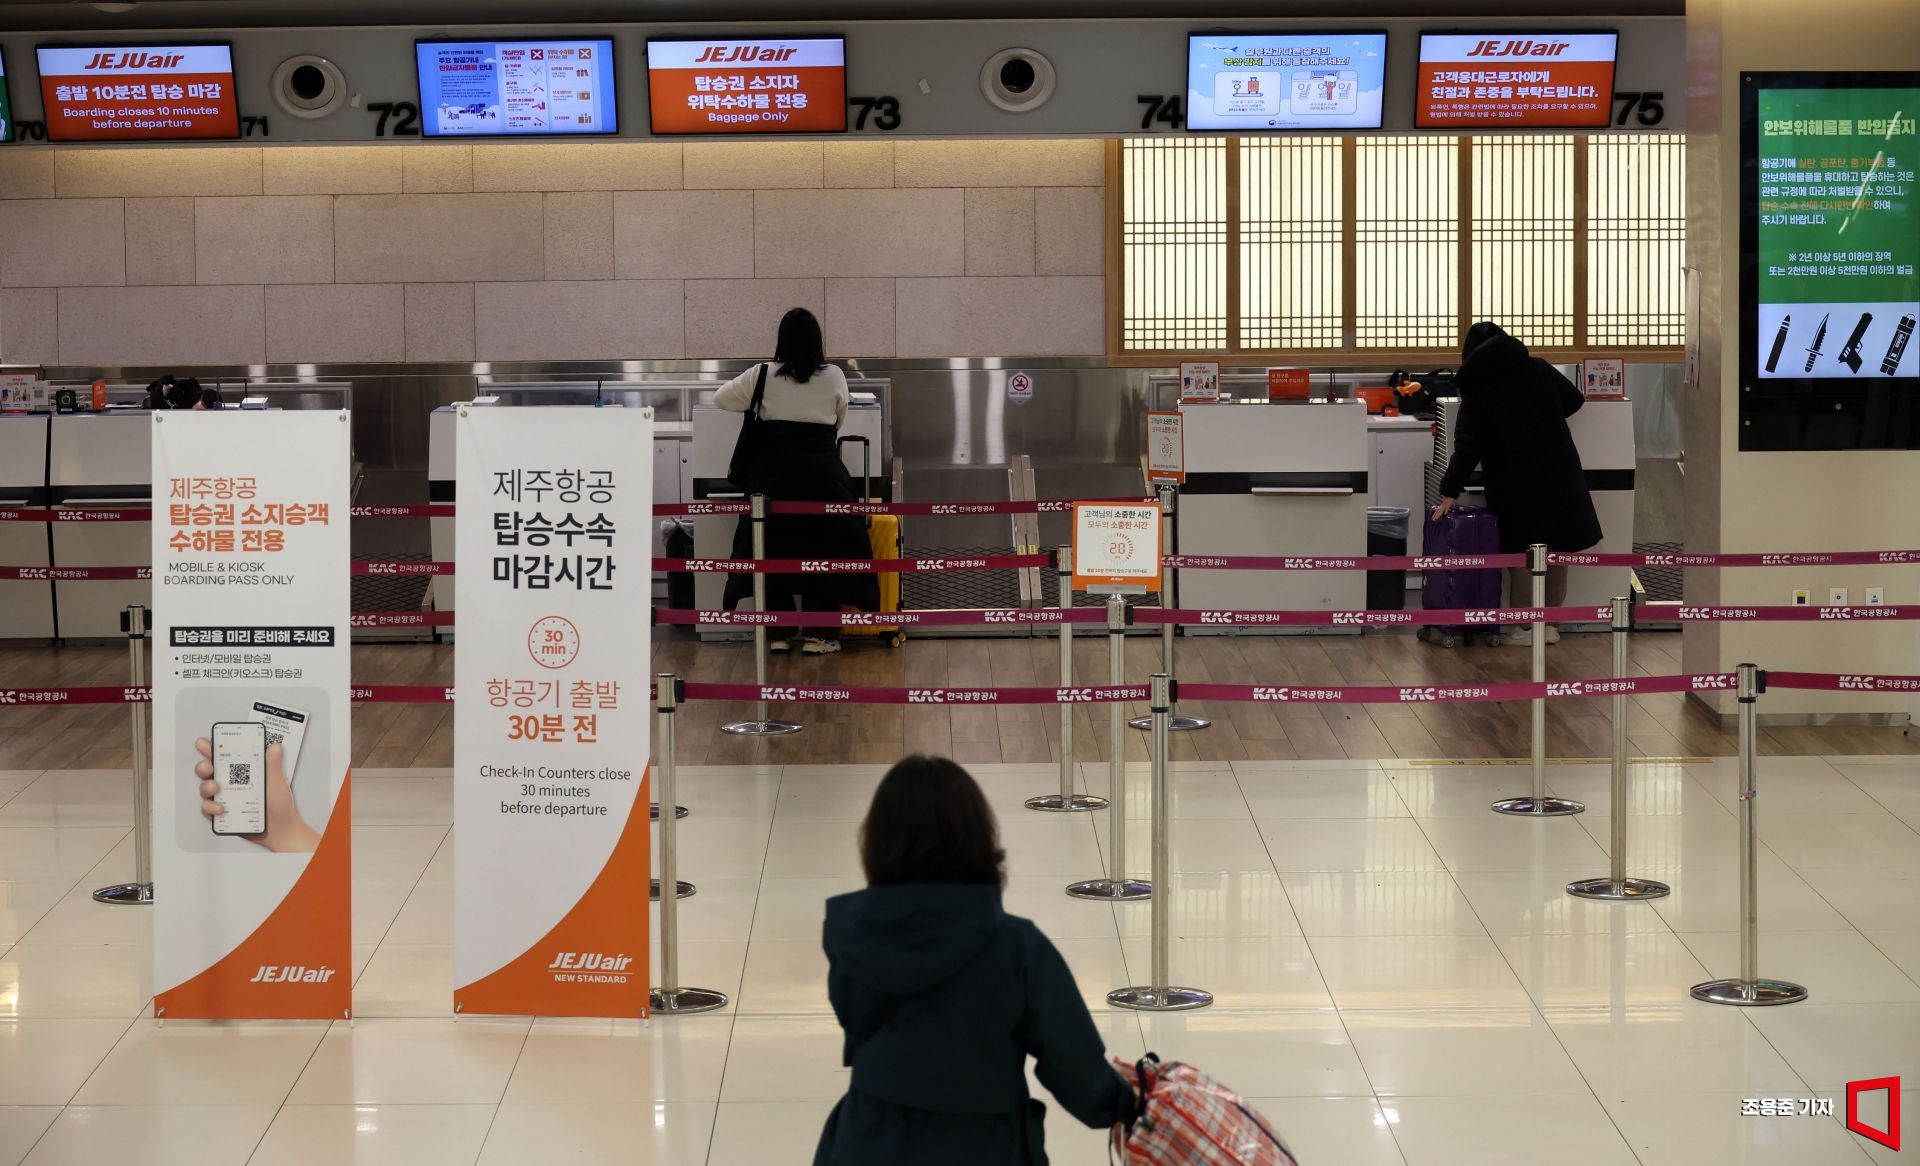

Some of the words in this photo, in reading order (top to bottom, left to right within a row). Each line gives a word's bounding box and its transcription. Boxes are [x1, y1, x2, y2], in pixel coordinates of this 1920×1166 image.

[695, 46, 797, 63] JEJUair
[1245, 48, 1281, 56] 승무원과
[1283, 48, 1301, 56] 다른
[1303, 48, 1330, 56] 승객의
[1466, 40, 1569, 57] JEJUair
[85, 52, 184, 69] JEJUair
[1272, 57, 1290, 66] 위해
[695, 76, 745, 92] 탑승권
[750, 75, 799, 91] 소지자
[1431, 71, 1549, 84] 고객응대근로자에게
[55, 86, 88, 101] 출발
[92, 86, 147, 101] 10분전
[151, 84, 183, 100] 탑승
[189, 83, 221, 99] 마감
[1431, 86, 1470, 99] 친절과
[1473, 86, 1512, 99] 존중을
[1516, 86, 1598, 98] 부탁드립니다.
[688, 94, 770, 110] 위탁수하물
[775, 93, 808, 109] 전용
[63, 107, 115, 119] Boarding
[118, 107, 154, 117] closes
[157, 106, 170, 116] 10
[173, 106, 219, 116] minutes
[851, 96, 900, 132] 73
[1137, 95, 1183, 129] 74
[1614, 92, 1664, 125] 75
[93, 119, 131, 129] before
[134, 118, 192, 130] departure
[366, 106, 417, 139] 72
[708, 112, 760, 124] Baggage
[761, 112, 789, 123] Only
[16, 121, 45, 141] 70
[241, 116, 268, 138] 71
[1764, 120, 1852, 136] 안보위해물품
[1857, 119, 1916, 136] 반입금지
[1761, 158, 1796, 168] 항공기에
[1886, 158, 1896, 168] 등
[1761, 172, 1822, 183] 안보위해물품을
[1824, 172, 1858, 183] 휴대하고
[1897, 172, 1914, 182] 것은
[1761, 187, 1779, 197] 관련
[1781, 187, 1807, 197] 규정에
[1809, 187, 1827, 197] 따라
[1864, 186, 1873, 196] 수
[1875, 186, 1904, 197] 있으니,
[1761, 215, 1787, 226] 주시기
[1789, 215, 1826, 225] 바랍니다.
[1799, 252, 1812, 262] 2년
[1814, 252, 1830, 262] 이상
[1833, 252, 1846, 262] 5년
[1848, 252, 1872, 262] 이하의
[1875, 252, 1891, 261] 징역
[1768, 267, 1785, 276] 또는
[1787, 266, 1817, 276] 2천만원
[1819, 266, 1836, 275] 이상
[1838, 266, 1867, 276] 5천만원
[1869, 266, 1894, 275] 이하의
[1897, 265, 1913, 275] 벌금
[170, 478, 257, 499] 제주항공
[493, 468, 616, 503] 제주항공
[59, 511, 84, 520] KAC
[170, 504, 235, 525] 탑승권
[241, 504, 329, 525] 소지승객
[1084, 510, 1112, 519] 고객님의
[1114, 511, 1136, 519] 소중한
[1137, 511, 1151, 519] 시간
[493, 512, 616, 547] 탑승수속
[1088, 520, 1109, 528] 모두의
[1110, 520, 1132, 529] 소중한
[1134, 520, 1148, 529] 시간
[170, 530, 235, 552] 수하물
[241, 530, 286, 552] 전용
[1109, 542, 1125, 554] 20
[169, 562, 214, 572] MOBILE
[217, 562, 226, 572] &
[229, 562, 265, 572] KIOSK
[369, 563, 397, 574] KAC
[399, 564, 439, 572] 한국공항공사
[685, 560, 714, 571] KAC
[716, 561, 756, 570] 한국공항공사
[1285, 558, 1312, 569] KAC
[1315, 559, 1356, 567] 한국공항공사
[20, 568, 47, 578] KAC
[49, 569, 89, 578] 한국공항공사
[493, 554, 616, 590] 마감시간
[164, 575, 226, 585] BOARDING
[229, 575, 260, 585] PASS
[262, 575, 295, 585] ONLY
[700, 611, 730, 623] KAC
[733, 614, 778, 623] 한국공항공사
[1200, 611, 1232, 624] KAC
[1235, 613, 1280, 622] 한국공항공사
[1679, 607, 1709, 619] KAC
[1712, 609, 1757, 618] 한국공항공사
[1820, 607, 1851, 619] KAC
[1853, 608, 1898, 617] 한국공항공사
[175, 630, 224, 643] 탑승권을
[227, 630, 251, 643] 미리
[254, 630, 291, 643] 준비해
[294, 630, 330, 643] 주세요
[544, 630, 563, 642] 30
[541, 644, 566, 654] min
[182, 654, 243, 664] 인터넷/모바일
[245, 653, 272, 664] 탑승권
[182, 668, 201, 678] 셀프
[203, 668, 273, 679] 체크인(키오스크)
[276, 668, 303, 679] 탑승권
[486, 678, 560, 708] 항공기
[569, 680, 620, 709] 출발
[761, 687, 797, 700] KAC
[799, 689, 850, 699] 한국공항공사
[1056, 688, 1092, 702] KAC
[1095, 688, 1146, 699] 한국공항공사
[1546, 681, 1582, 696] KAC
[1585, 681, 1636, 692] 한국공항공사
[507, 714, 566, 741] 30분
[572, 714, 597, 742] 전
[480, 765, 535, 778] Check-In
[538, 766, 595, 780] Counters
[598, 767, 631, 780] close
[521, 784, 535, 796] 30
[539, 784, 590, 798] minutes
[501, 801, 540, 814] before
[544, 802, 607, 818] departure
[549, 952, 634, 970] JEJUair
[250, 966, 335, 984] JEJUair
[555, 974, 575, 982] NEW
[578, 974, 626, 983] STANDARD
